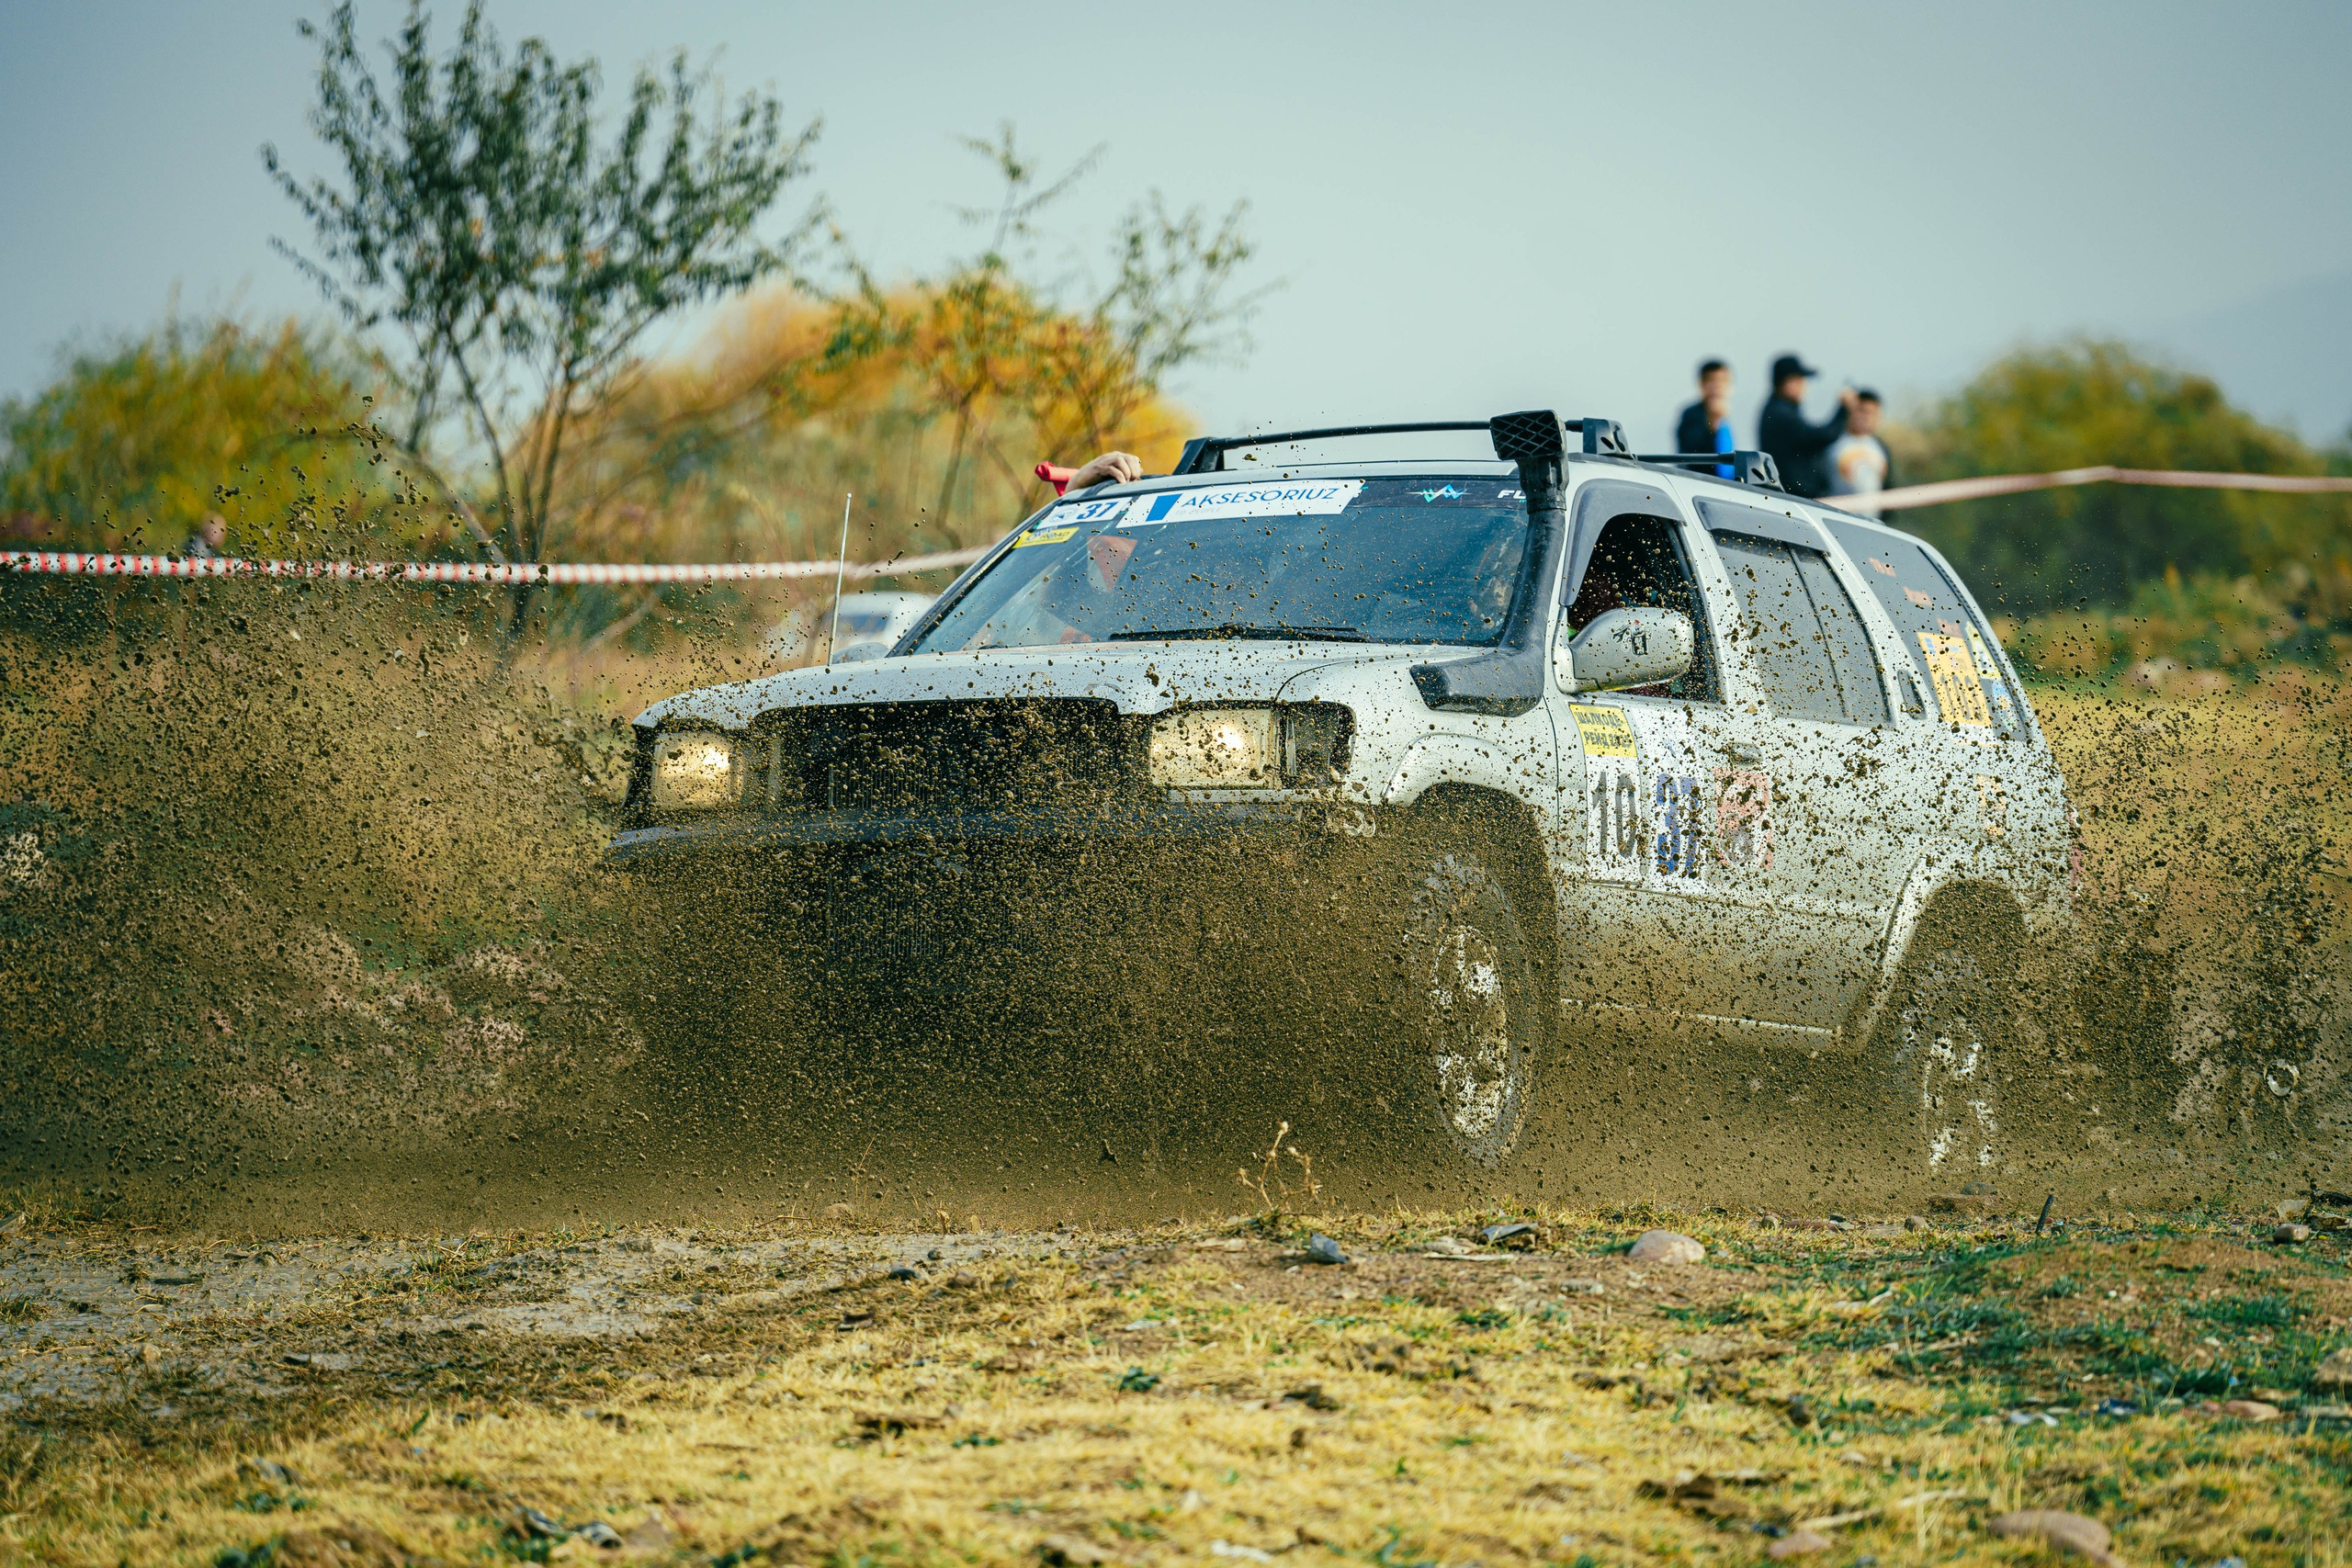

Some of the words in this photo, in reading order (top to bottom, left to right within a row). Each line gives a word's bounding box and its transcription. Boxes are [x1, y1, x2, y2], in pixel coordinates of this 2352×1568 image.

[1182, 488, 1340, 508] AKSESORIUZ
[1076, 502, 1119, 519] 37
[1592, 771, 1636, 858] 10
